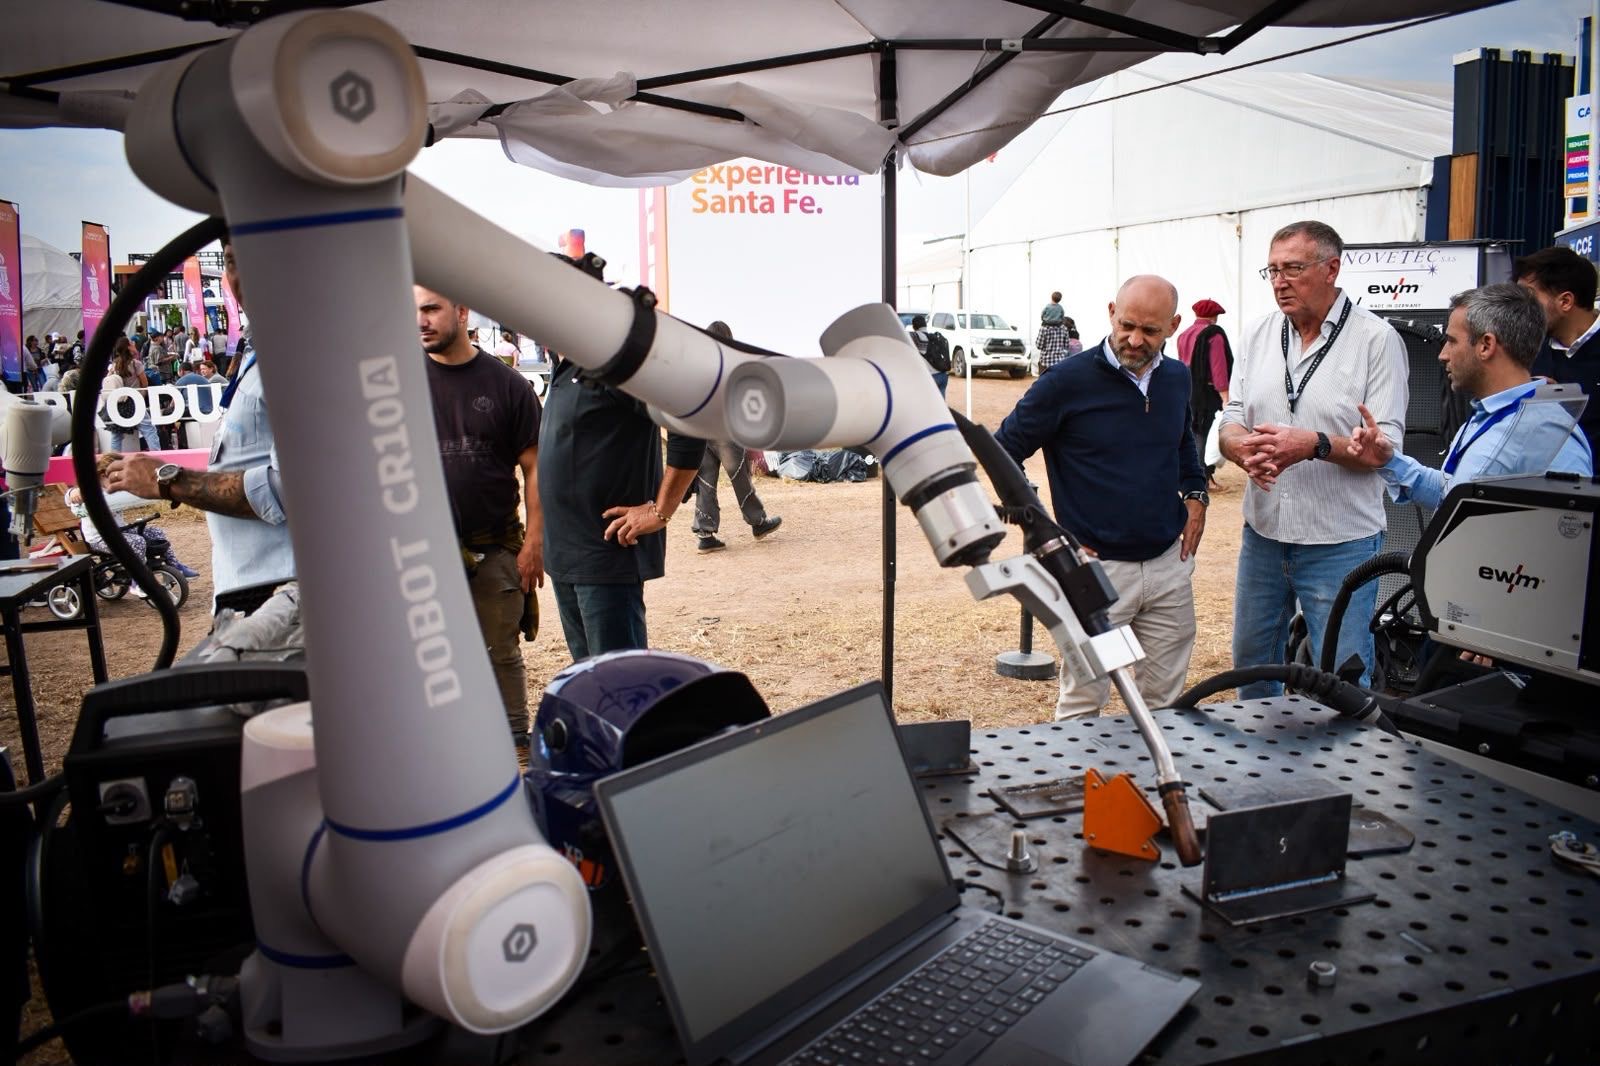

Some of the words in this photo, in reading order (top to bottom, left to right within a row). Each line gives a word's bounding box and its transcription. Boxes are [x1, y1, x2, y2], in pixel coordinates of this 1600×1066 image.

[692, 188, 775, 214] Santa
[783, 189, 823, 214] Fe.
[1342, 250, 1440, 266] NOVETEC
[33, 382, 222, 430] PODU
[358, 355, 420, 515] CR10A
[1478, 565, 1540, 592] ewm
[390, 536, 463, 708] DOBOT
